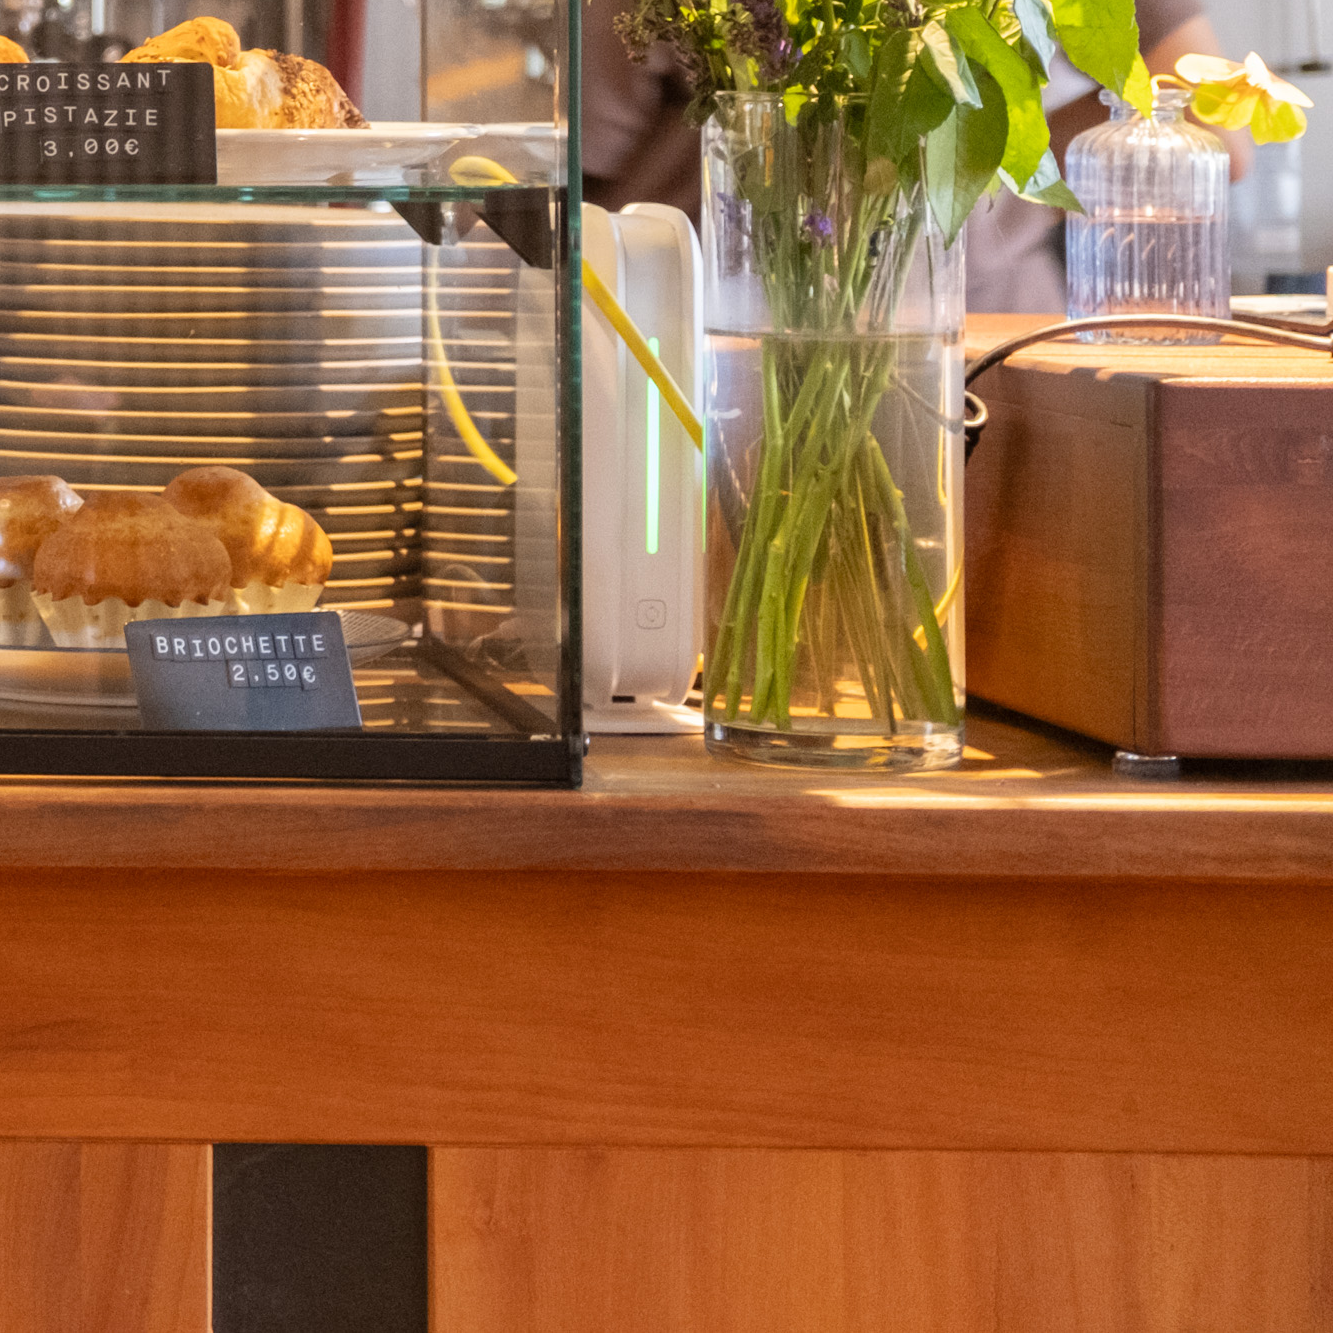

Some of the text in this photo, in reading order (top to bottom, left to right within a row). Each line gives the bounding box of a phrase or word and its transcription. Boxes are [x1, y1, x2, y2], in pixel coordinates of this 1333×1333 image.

[3, 108, 160, 129] PISTAZIE
[43, 138, 140, 158] 3,00€
[156, 634, 327, 658] BRIOCHETTE
[233, 662, 317, 684] 2,50€
